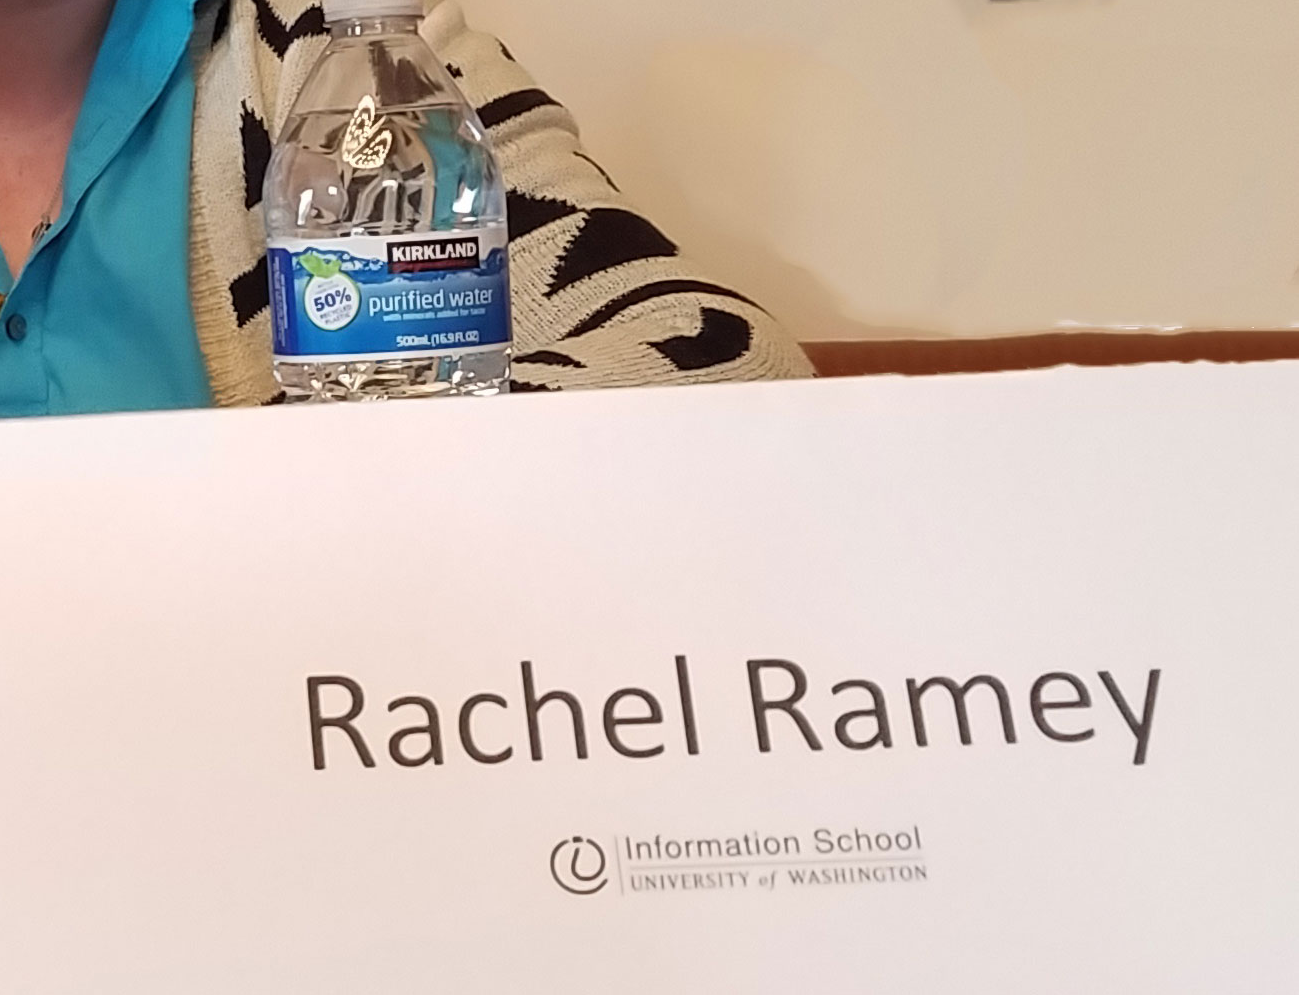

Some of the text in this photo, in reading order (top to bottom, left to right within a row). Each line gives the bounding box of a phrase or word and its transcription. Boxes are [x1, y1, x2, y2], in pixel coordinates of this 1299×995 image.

[392, 242, 477, 262] KIRKLAND
[313, 287, 352, 312] 50%
[369, 287, 493, 317] purified water
[306, 655, 1162, 771] Rachel Ramey
[626, 826, 922, 861] Information School
[631, 865, 928, 892] UNIVERSITY of WASHINGTON
